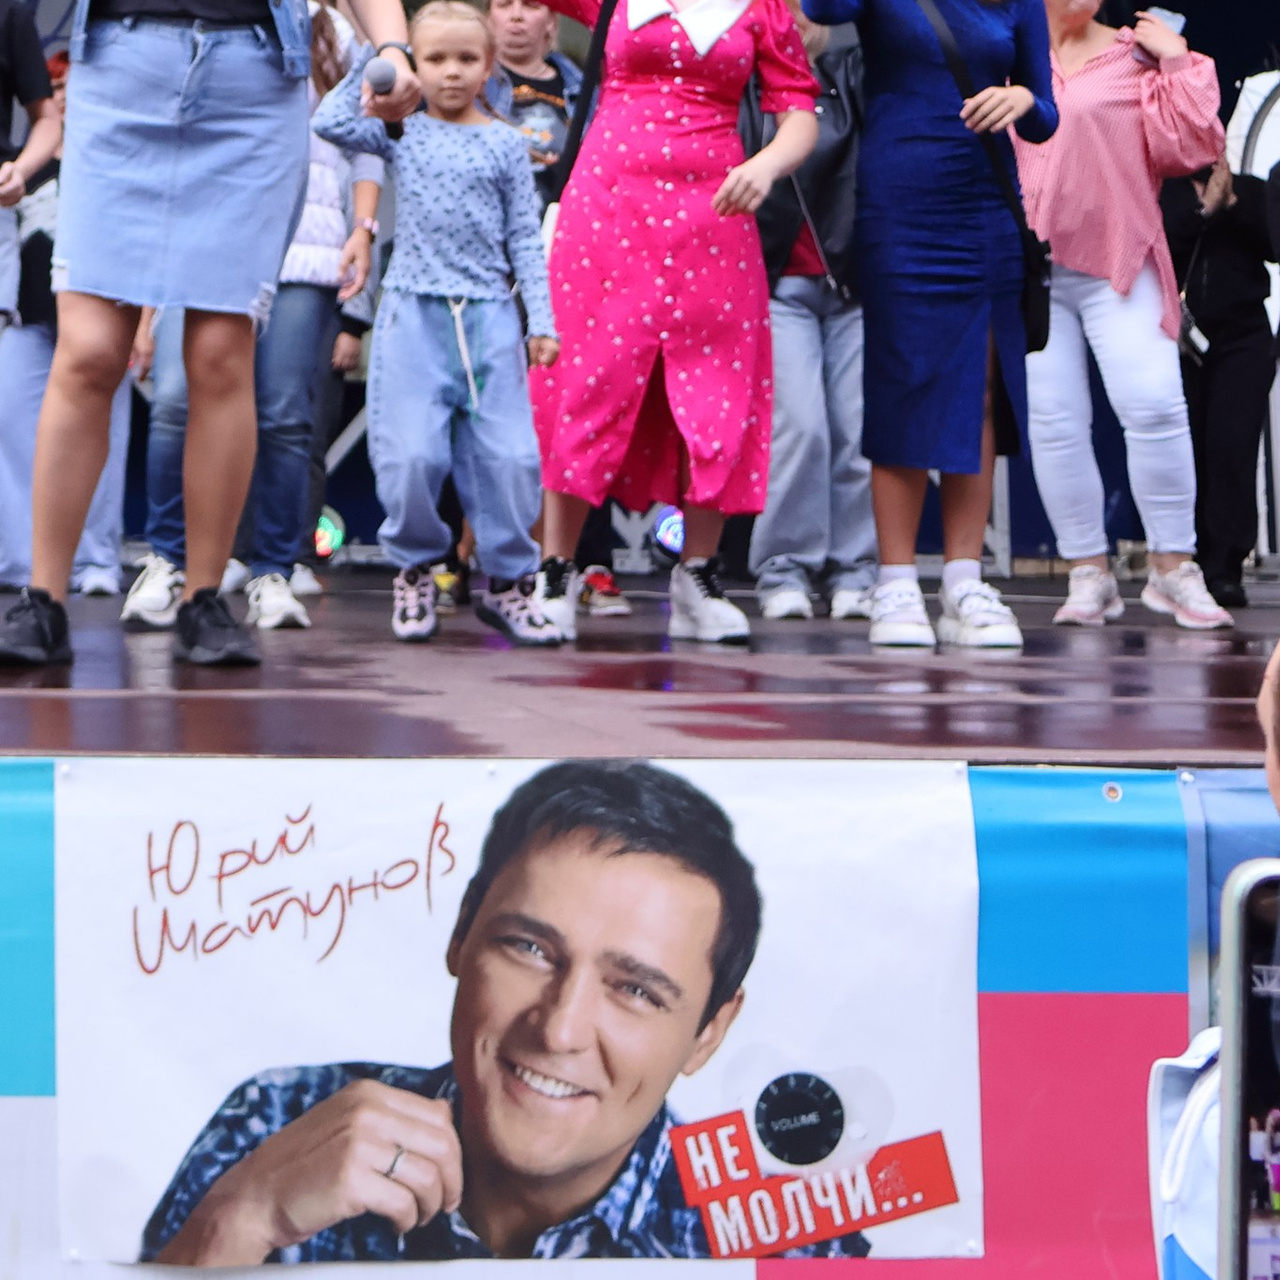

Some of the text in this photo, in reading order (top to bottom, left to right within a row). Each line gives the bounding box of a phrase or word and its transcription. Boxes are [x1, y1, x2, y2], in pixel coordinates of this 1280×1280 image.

[132, 802, 456, 975] Шатунов
[147, 802, 315, 911] Юрий
[685, 1123, 751, 1191] НЕ
[770, 1111, 821, 1132] VOLUME
